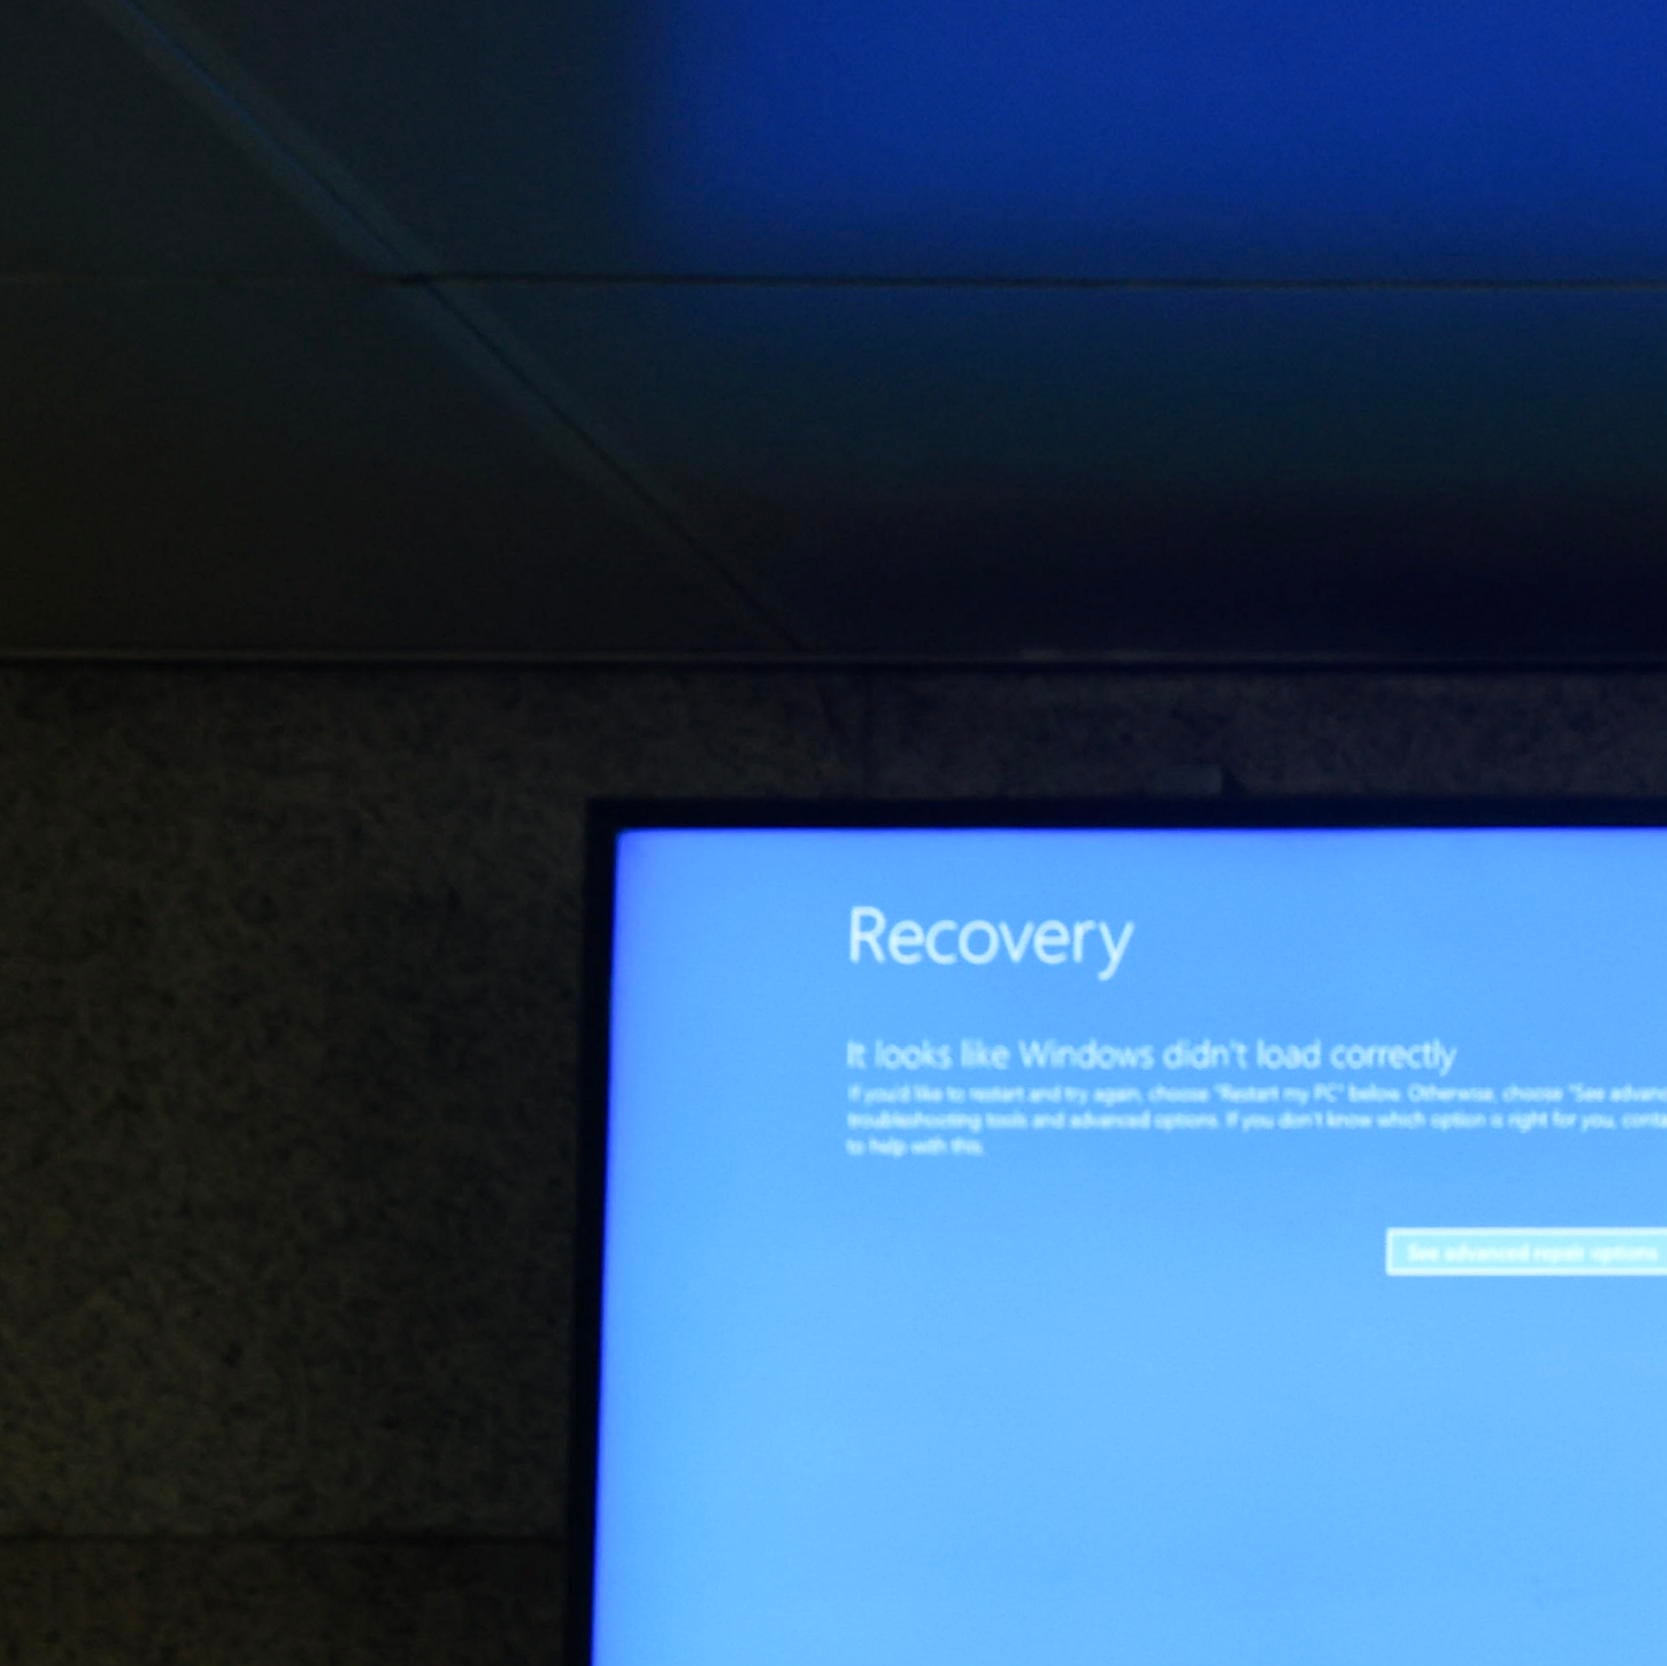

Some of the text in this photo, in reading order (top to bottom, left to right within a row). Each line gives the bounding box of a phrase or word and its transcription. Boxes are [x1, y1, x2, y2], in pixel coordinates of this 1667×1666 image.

[849, 905, 1135, 981] Recovery
[845, 1038, 1458, 1073] It looks like Windows didn't load correctly
